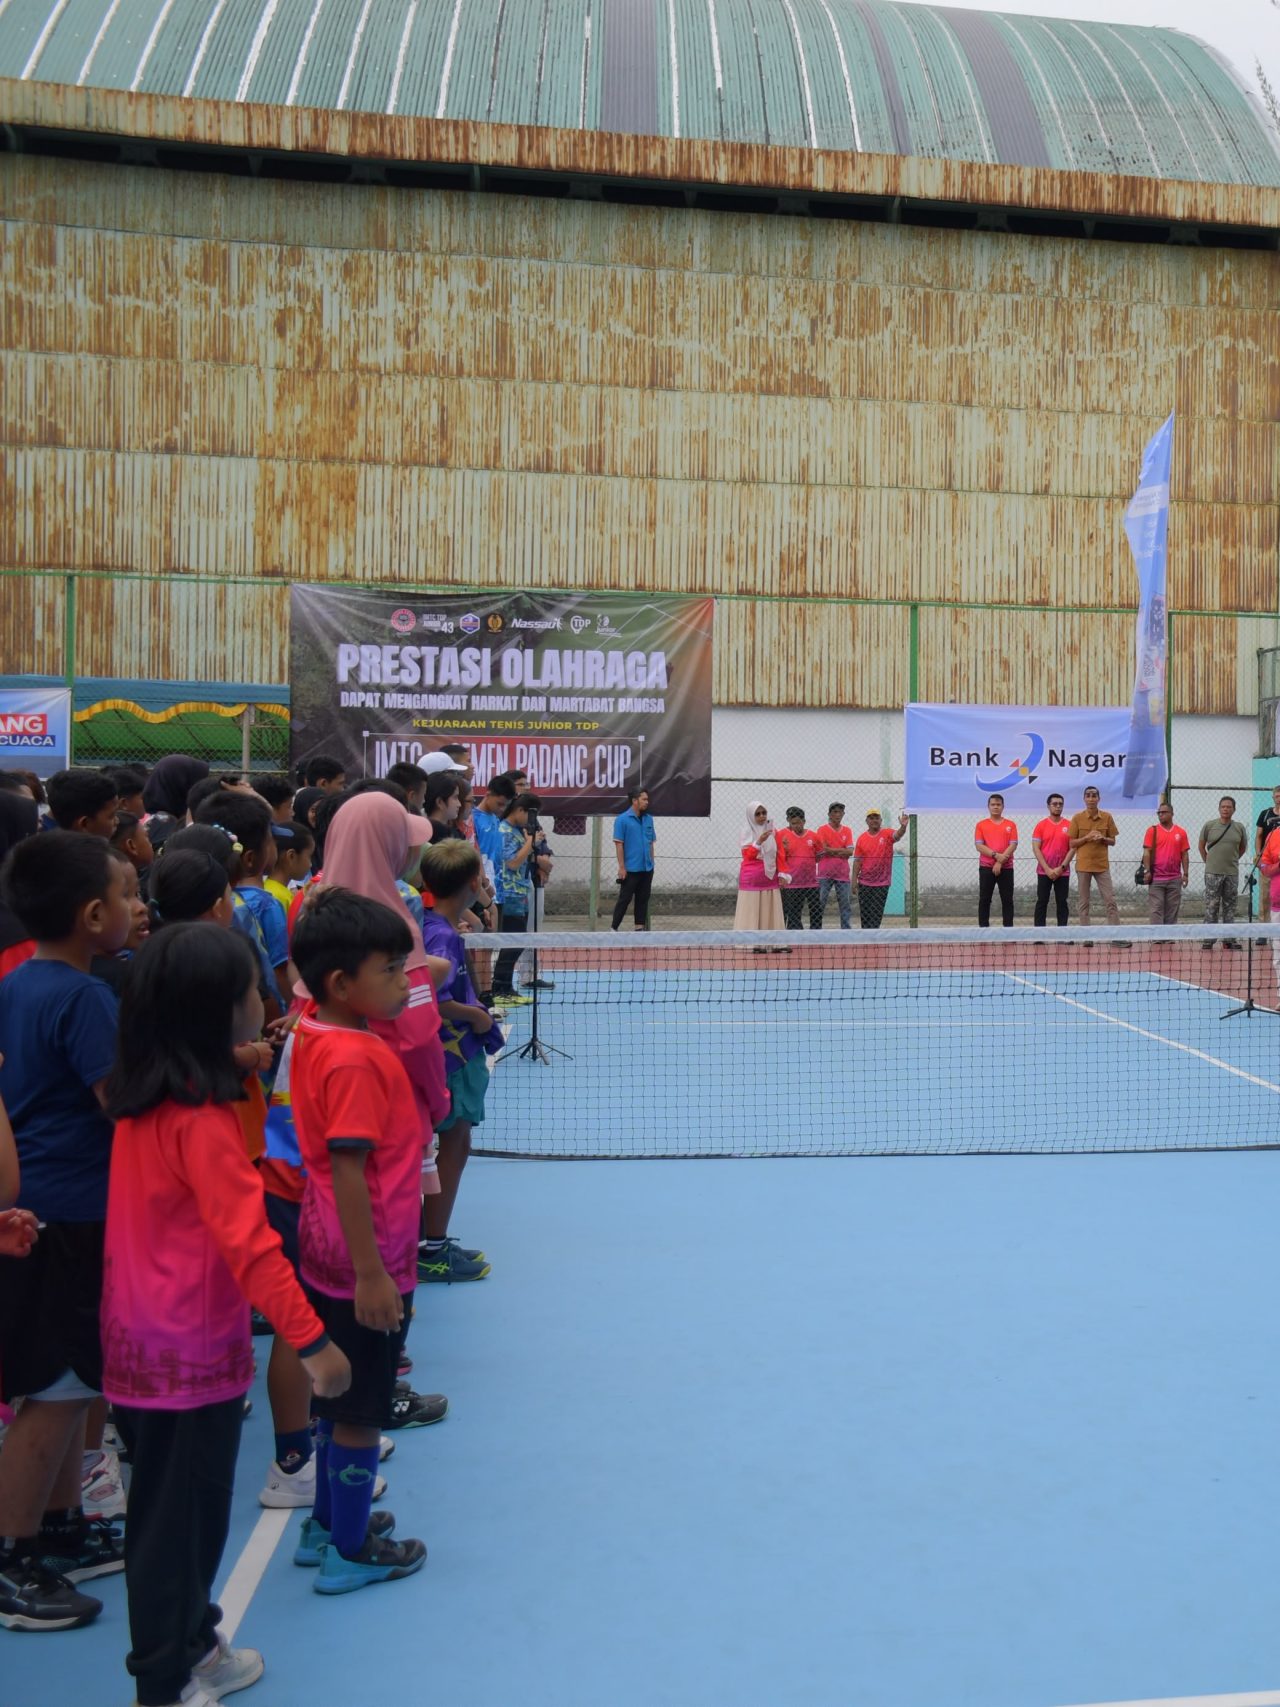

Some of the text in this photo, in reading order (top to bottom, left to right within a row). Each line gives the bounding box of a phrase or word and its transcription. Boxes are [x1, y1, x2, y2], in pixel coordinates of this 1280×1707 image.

[441, 621, 454, 634] 43
[511, 618, 558, 629] Nassau
[573, 618, 591, 628] TDP
[337, 643, 668, 689] PRESTASI OLAHRAGA
[340, 691, 665, 714] DAPAT MENGANGKAT HARKAT DAN MARTABAT BANGSA
[412, 719, 600, 731] KEJUARAAN TENIS JUNIOR TDP
[451, 742, 509, 787] MEN
[515, 743, 588, 788] PADANG
[594, 744, 631, 788] CUP
[930, 747, 1127, 773] Bank Nagar
